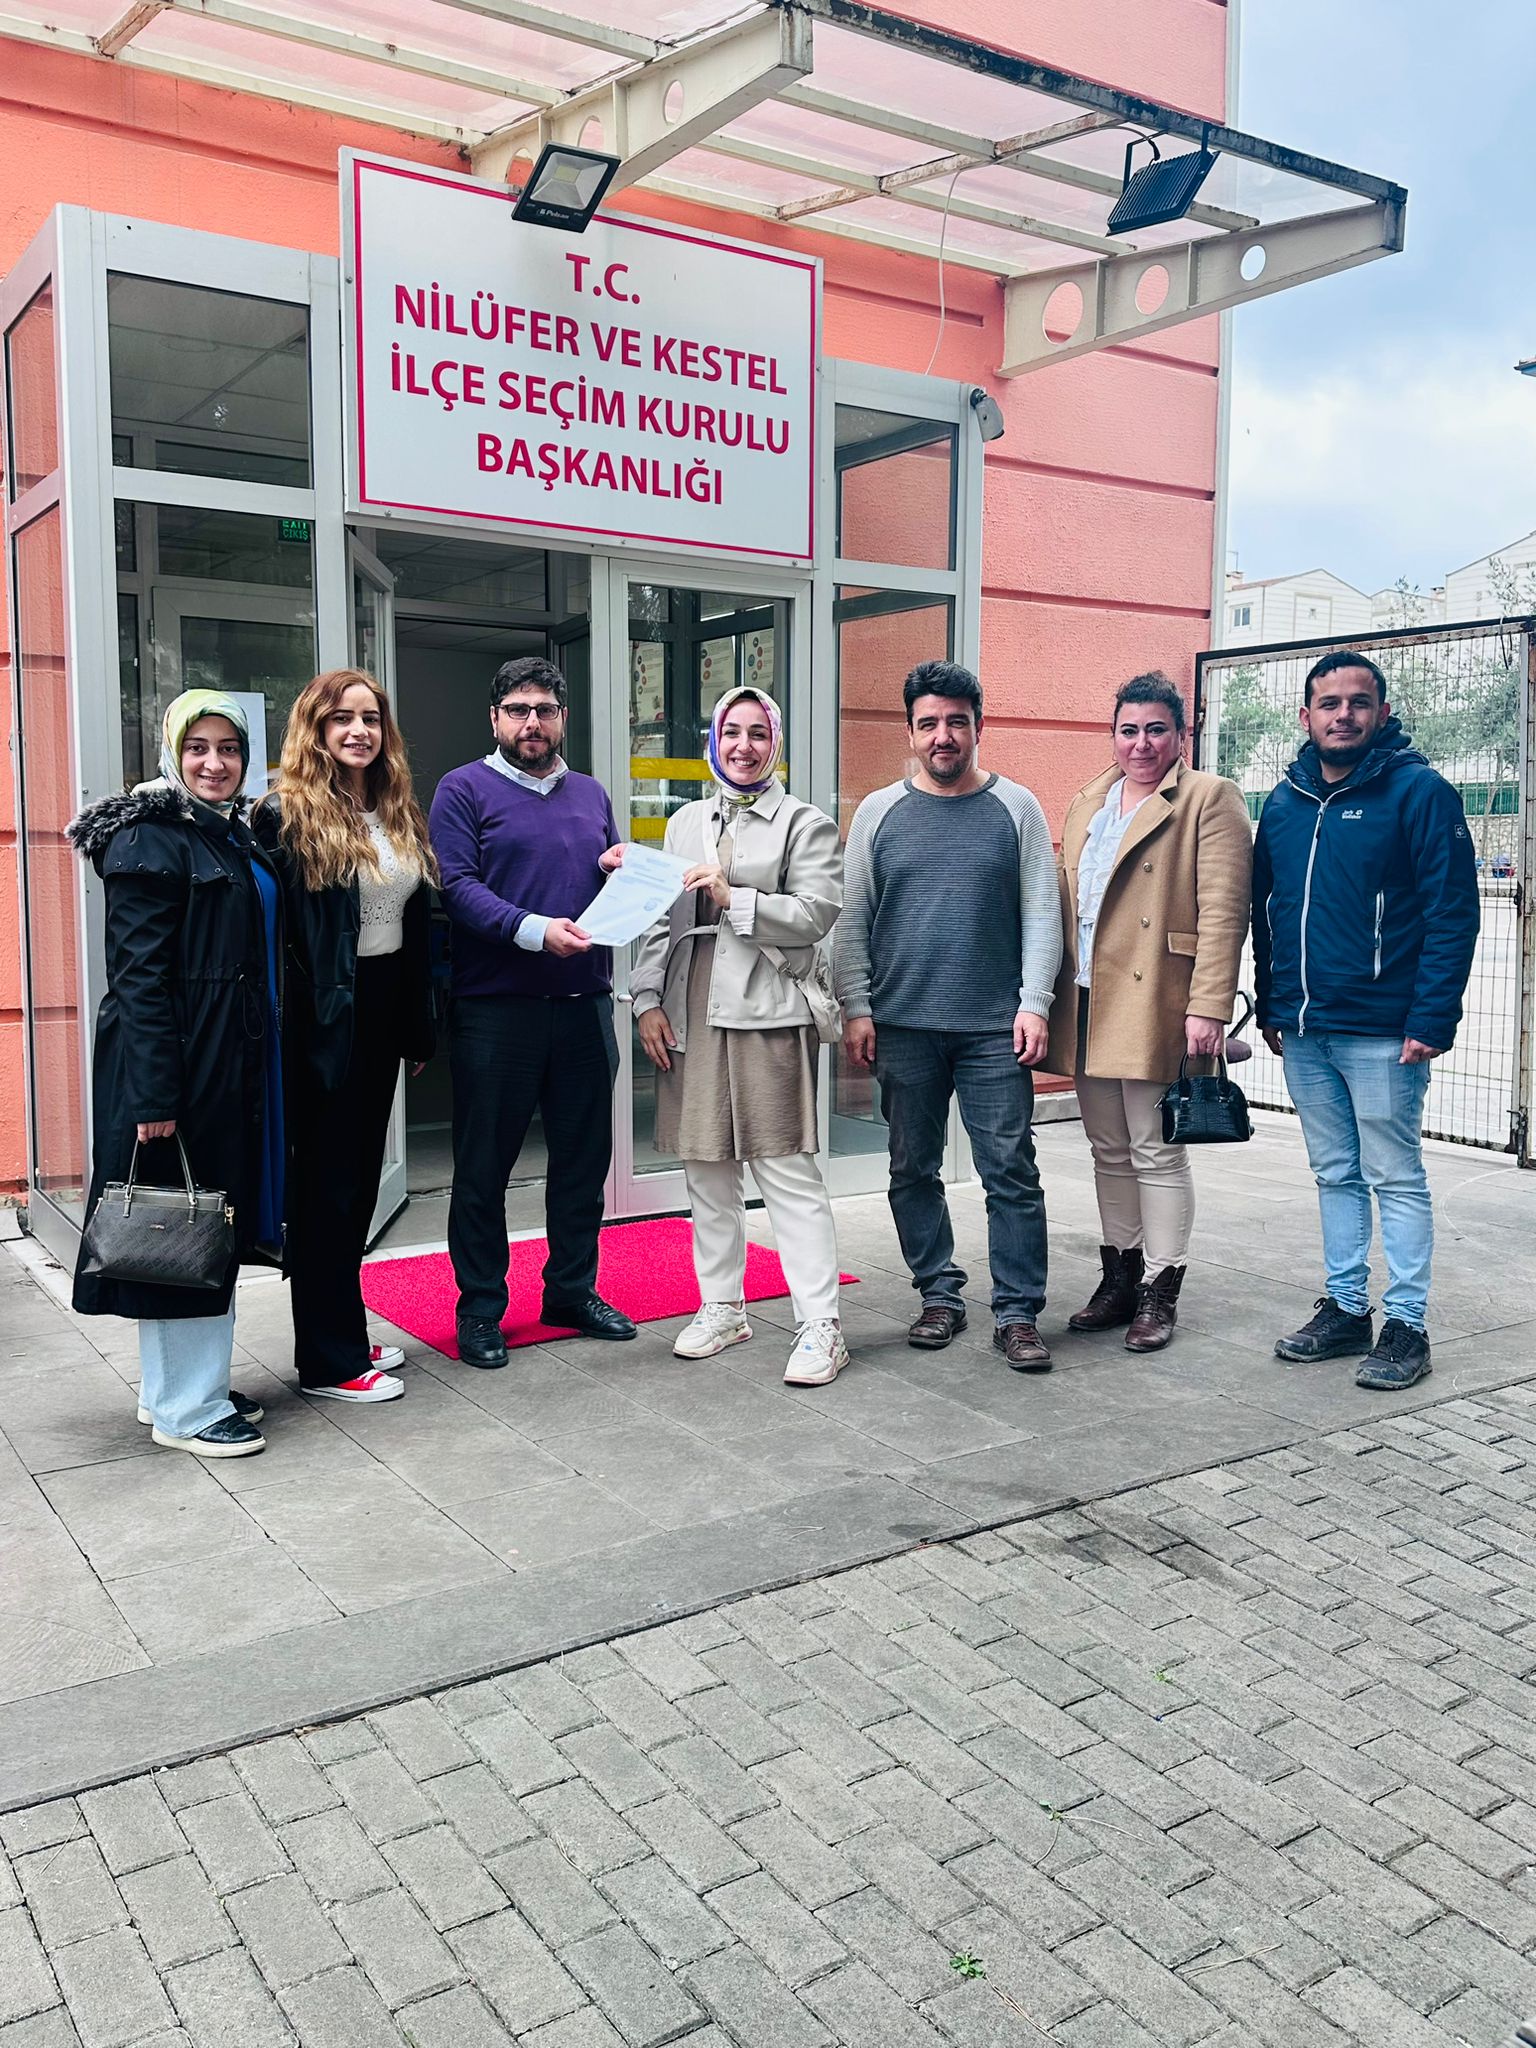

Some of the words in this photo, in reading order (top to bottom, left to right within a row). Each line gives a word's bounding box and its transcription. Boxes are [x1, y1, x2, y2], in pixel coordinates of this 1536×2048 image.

[566, 252, 642, 305] T.C.
[395, 281, 580, 358] NİLÜFER
[590, 321, 642, 370] VE
[653, 335, 788, 396] KESTEL
[391, 341, 487, 413] İLÇE
[497, 370, 627, 431] SEÇİM
[638, 395, 791, 456] KURULU
[477, 432, 724, 506] BAŞKANLIĞI
